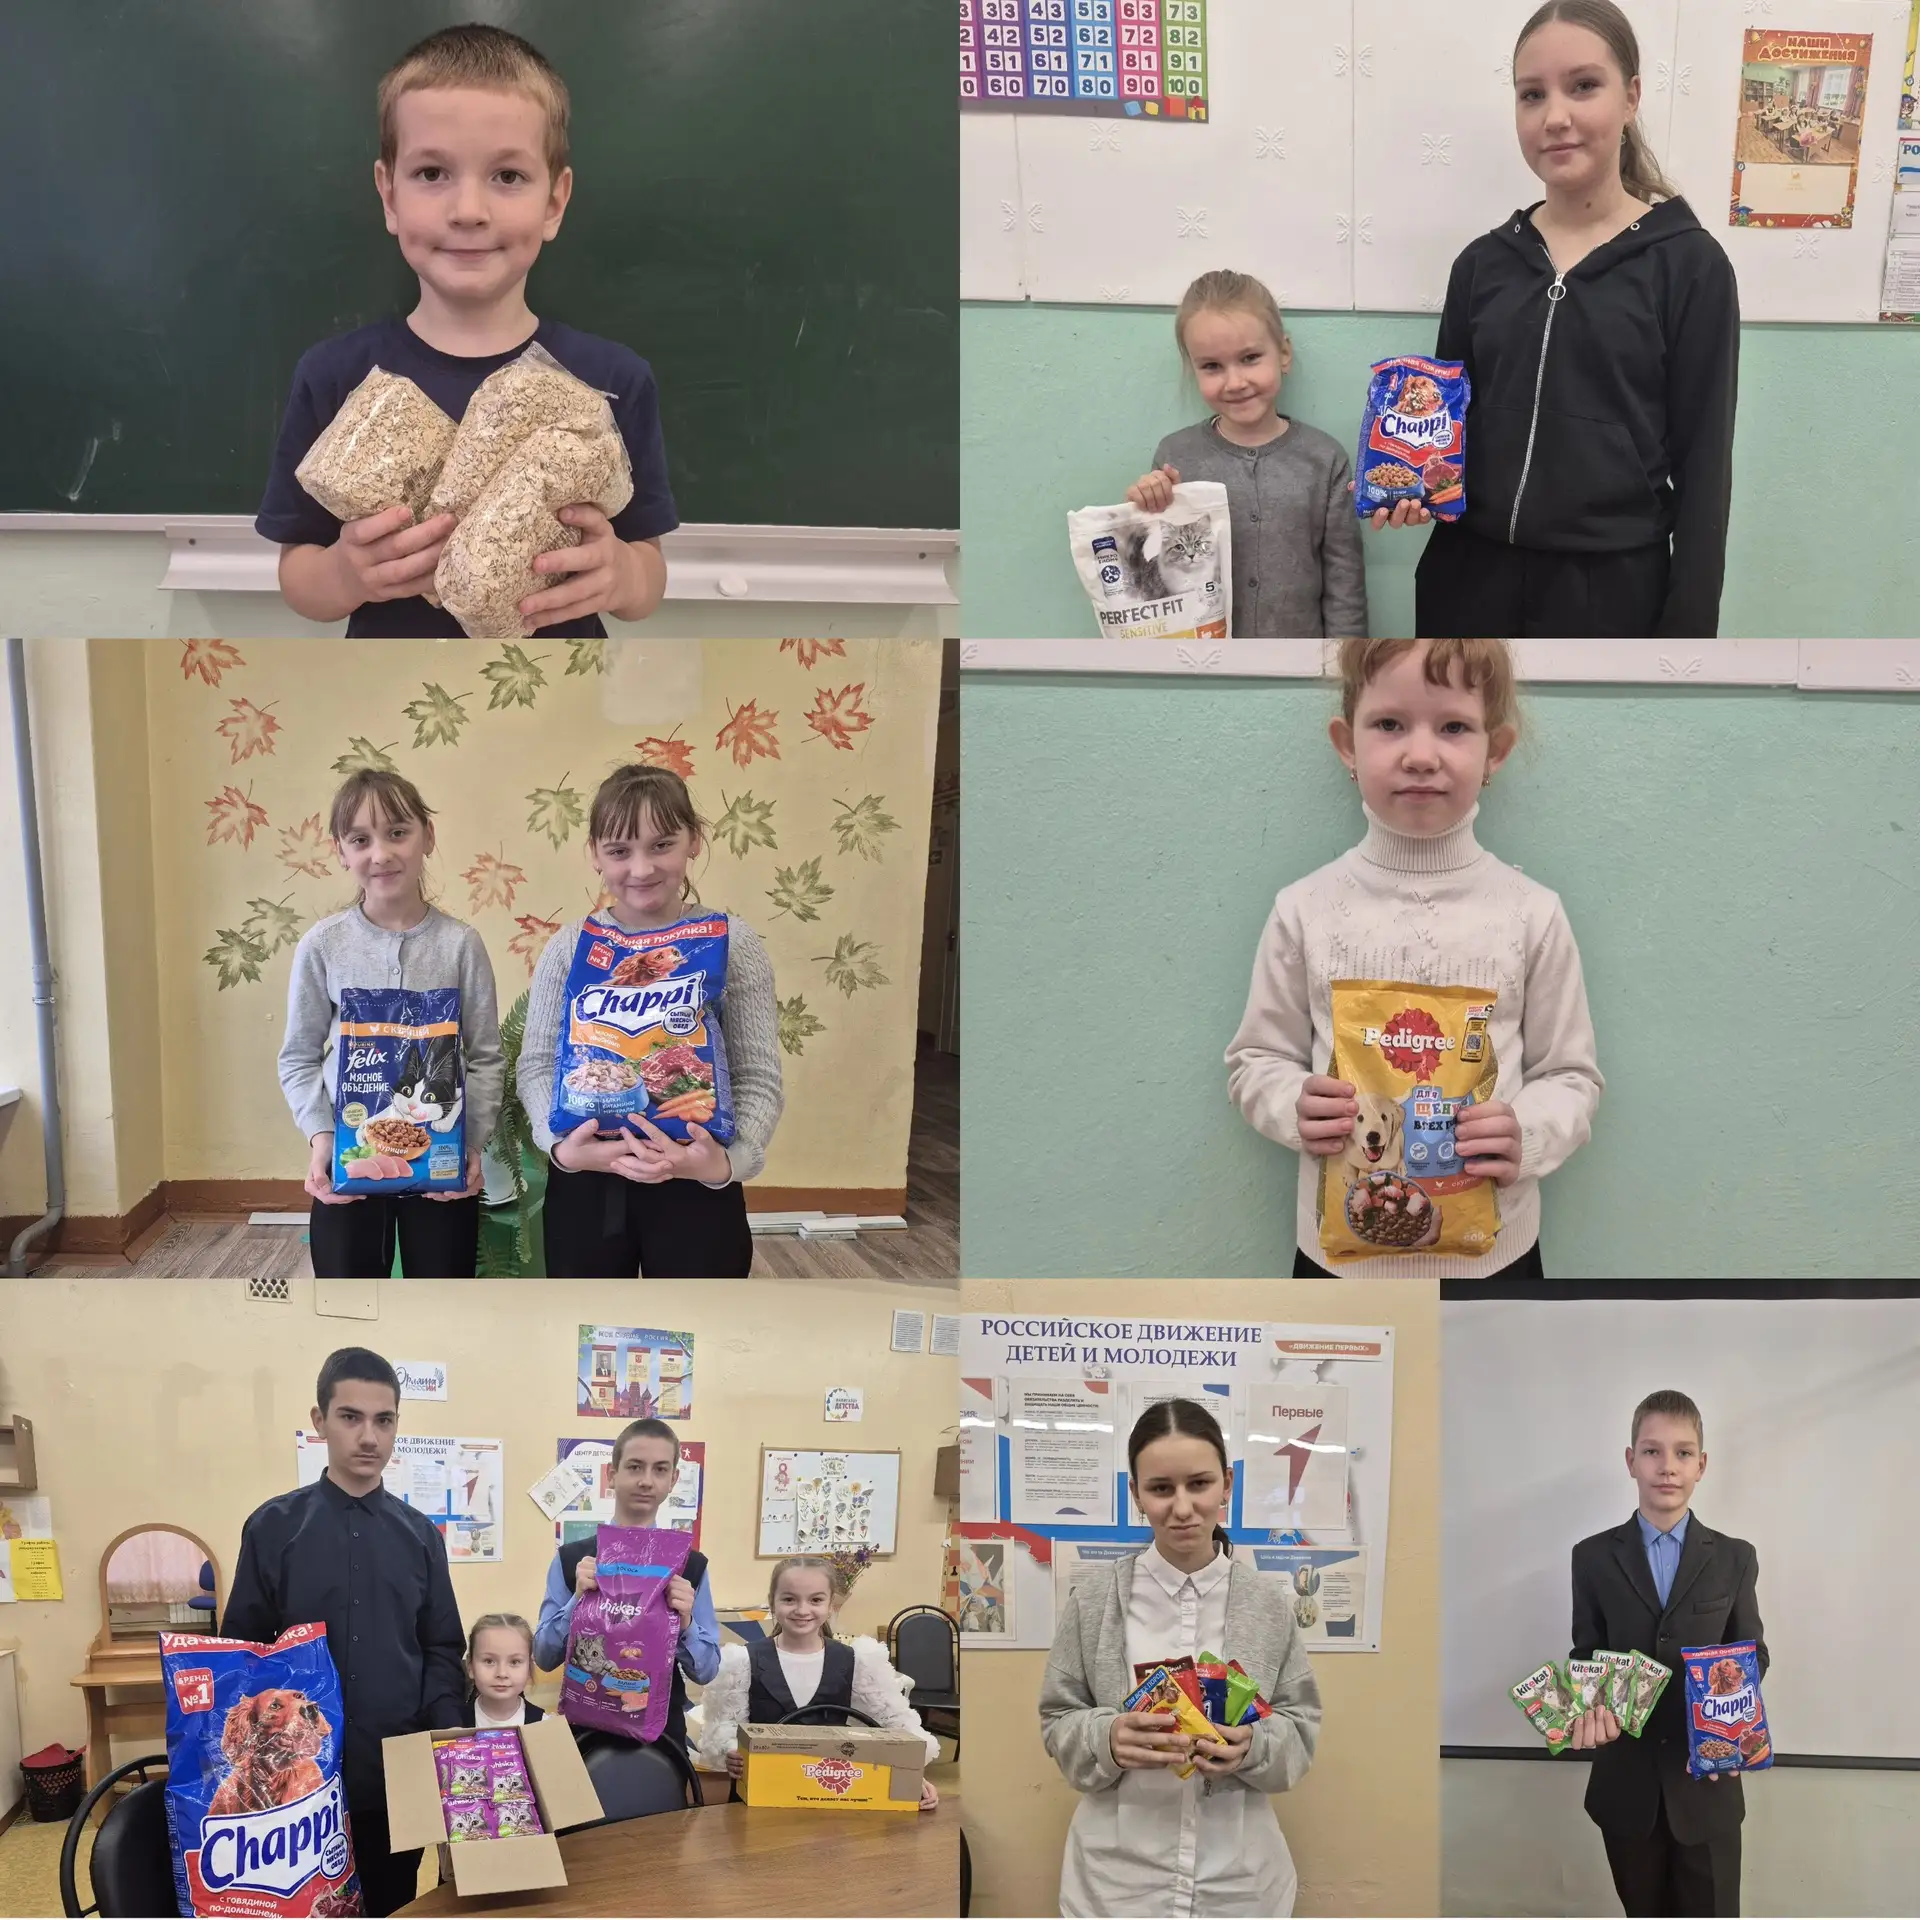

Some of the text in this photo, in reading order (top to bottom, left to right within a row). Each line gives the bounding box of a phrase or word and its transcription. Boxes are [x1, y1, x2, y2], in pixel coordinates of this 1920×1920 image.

[987, 3, 1015, 18] 33
[1031, 2, 1065, 18] 43
[1078, 2, 1107, 19] 53
[1123, 3, 1152, 18] 63
[1169, 5, 1198, 19] 73
[987, 29, 1017, 44] 42
[1033, 28, 1063, 44] 52
[1079, 28, 1108, 44] 62
[1125, 29, 1153, 44] 72
[1170, 30, 1198, 45] 82
[1787, 36, 1830, 49] НАШИ
[990, 54, 1016, 69] 51
[1035, 54, 1062, 69] 61
[1081, 54, 1107, 69] 71
[1126, 54, 1152, 69] 81
[1170, 54, 1197, 69] 91
[1758, 47, 1857, 62] ДОСТИЖЕНИЯ
[991, 79, 1020, 94] 60
[1037, 79, 1066, 94] 70
[1082, 79, 1111, 94] 80
[1126, 79, 1155, 94] 90
[1169, 79, 1199, 95] 100
[1903, 144, 1920, 155] РО
[1380, 412, 1447, 437] Chappi
[1205, 581, 1215, 592] 5
[1100, 599, 1183, 625] PERFECT FIT
[576, 978, 698, 1022] Chappi
[1363, 1027, 1456, 1052] Pedigree
[350, 1072, 382, 1082] МЯСНОЕ
[342, 1082, 389, 1093] ОБЪЕДЕНИЕ
[568, 1094, 595, 1108] 100%
[981, 1318, 1133, 1339] РОССИЙСКОЕ
[1137, 1324, 1262, 1343] ДВИЖЕНИЕ
[1006, 1343, 1237, 1368] ДЕТЕЙ И МОЛОДЕЖИ
[1272, 1405, 1324, 1420] Первые
[410, 1437, 456, 1446] ДВИЖЕНИЕ
[397, 1446, 447, 1455] МОЛОДЕЖИ
[1600, 1654, 1630, 1668] kitekat
[1638, 1656, 1662, 1677] itekat
[1572, 1664, 1603, 1674] kitekat
[1517, 1670, 1549, 1696] kitekat
[1701, 1690, 1753, 1719] Chappi
[804, 1764, 863, 1779] Pedigree
[200, 1789, 339, 1889] Chappi
[227, 1897, 277, 1909] говядиной
[210, 1905, 283, 1919] по-домашнему
